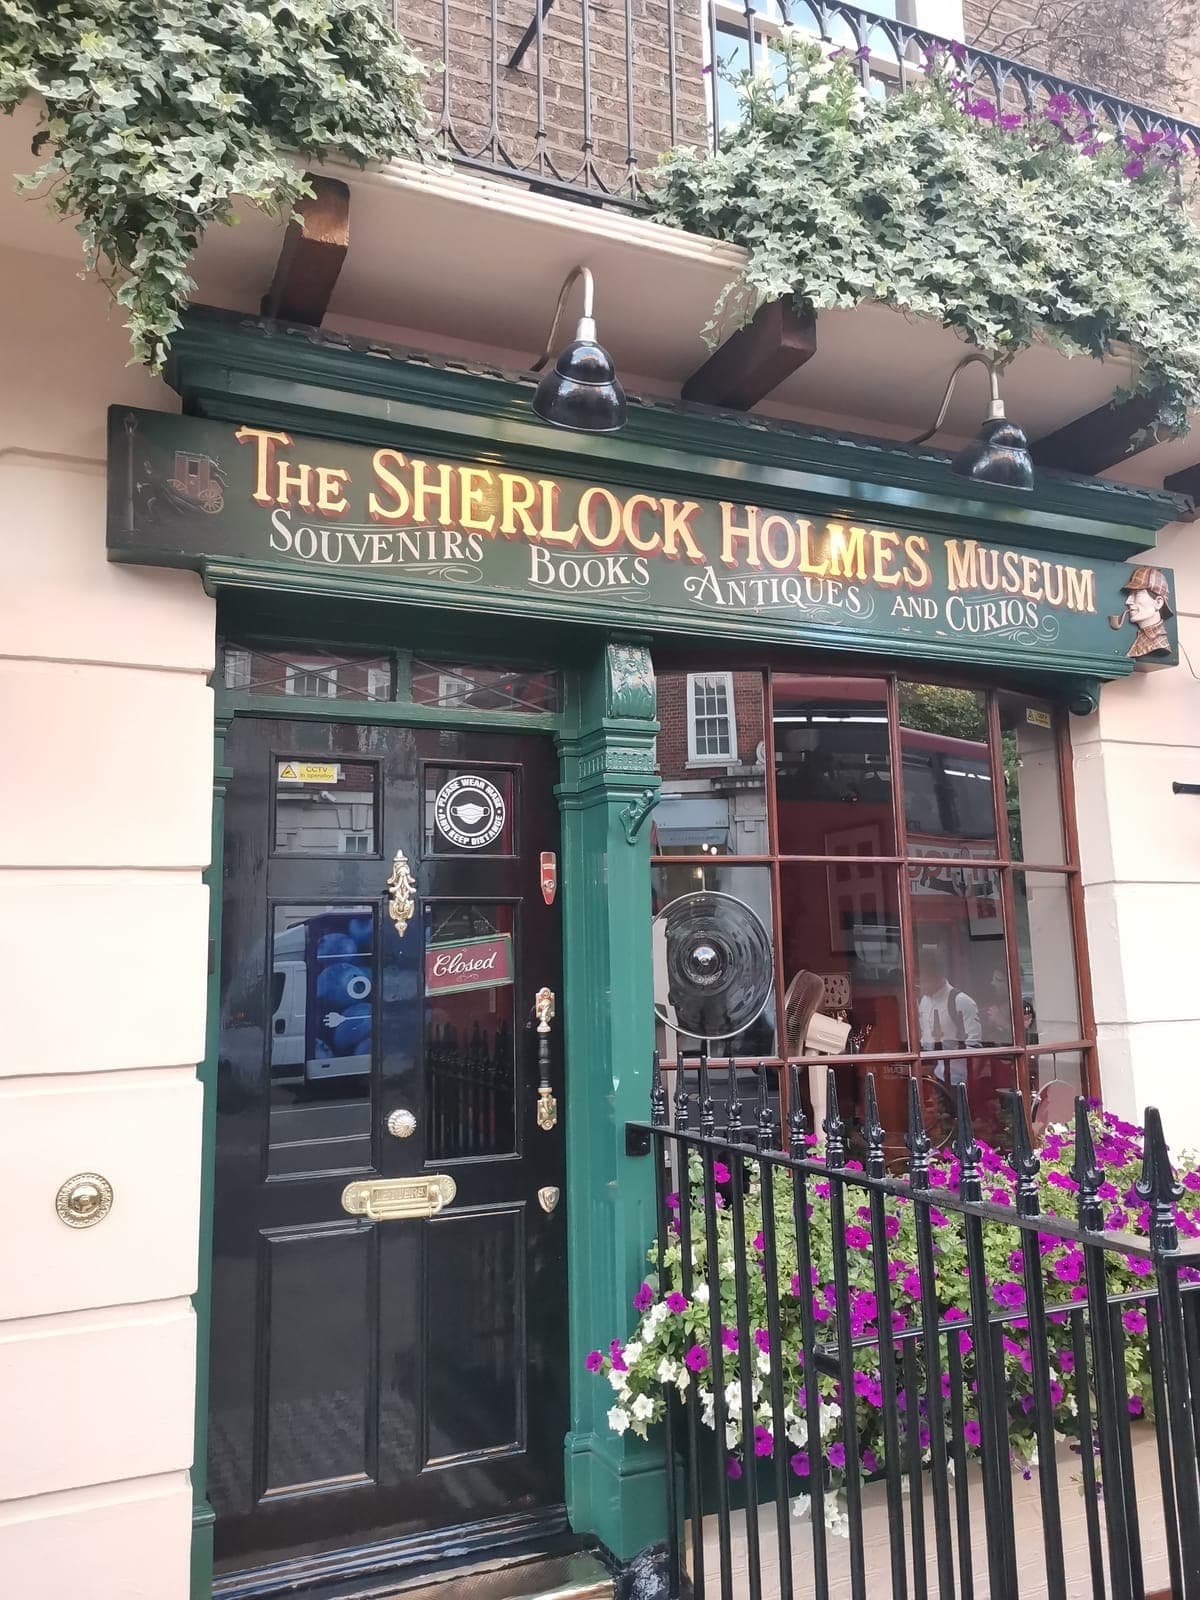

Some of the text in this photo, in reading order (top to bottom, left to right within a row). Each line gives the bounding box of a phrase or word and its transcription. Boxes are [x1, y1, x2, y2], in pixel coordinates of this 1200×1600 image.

[235, 425, 1096, 614] THE SHERLOCK HOLMES MUSEUM
[269, 509, 1039, 633] SOUVENIRS BOOKS ANTIQUES AND CURIOS
[439, 779, 502, 808] PLEASE WEAR MASK
[438, 814, 502, 845] AND KEEP DISTANCE
[433, 951, 498, 977] Closed
